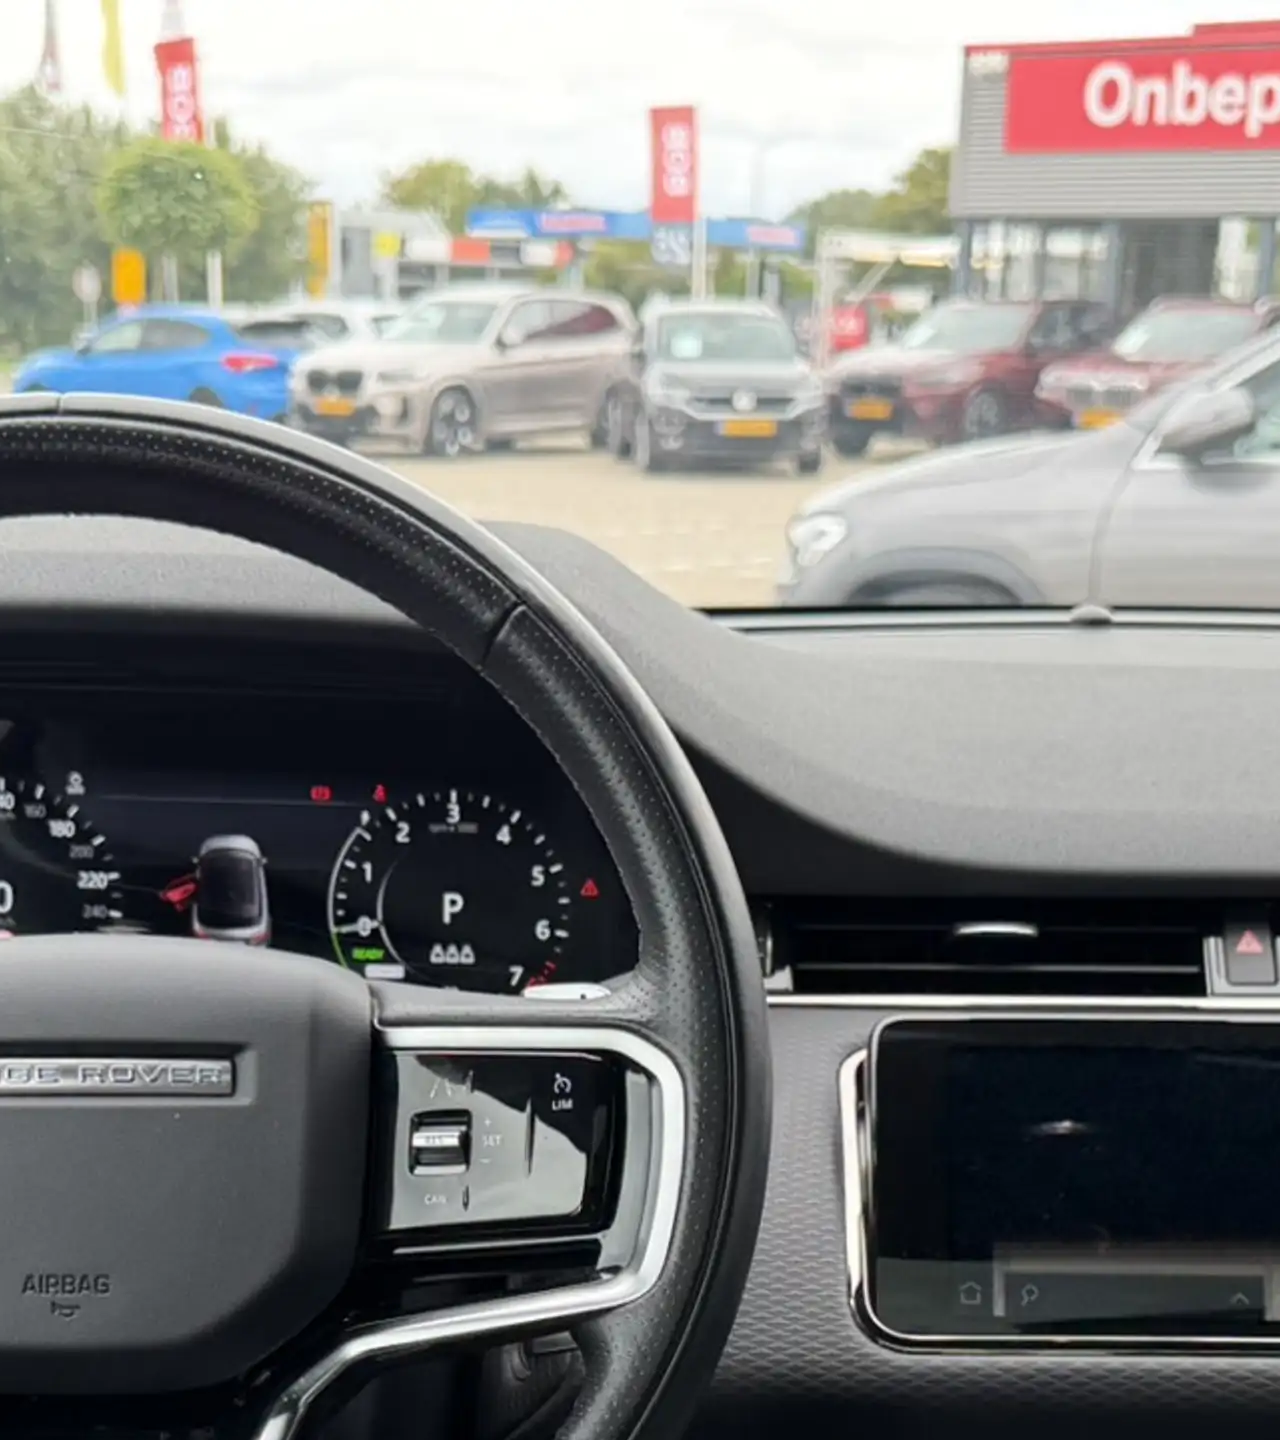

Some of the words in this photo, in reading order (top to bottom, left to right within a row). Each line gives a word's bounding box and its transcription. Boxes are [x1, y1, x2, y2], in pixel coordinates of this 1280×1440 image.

[447, 803, 460, 824] 3
[47, 819, 76, 838] 180
[395, 822, 410, 843] 2
[496, 824, 512, 845] 4
[76, 870, 108, 889] 220
[362, 861, 372, 882] 1
[531, 865, 545, 887] 5
[442, 891, 464, 924] P
[535, 919, 551, 940] 6
[509, 965, 523, 986] 7
[77, 1063, 223, 1086] ROVER
[482, 1134, 502, 1146] SET
[21, 1273, 110, 1295] AIRBAG
